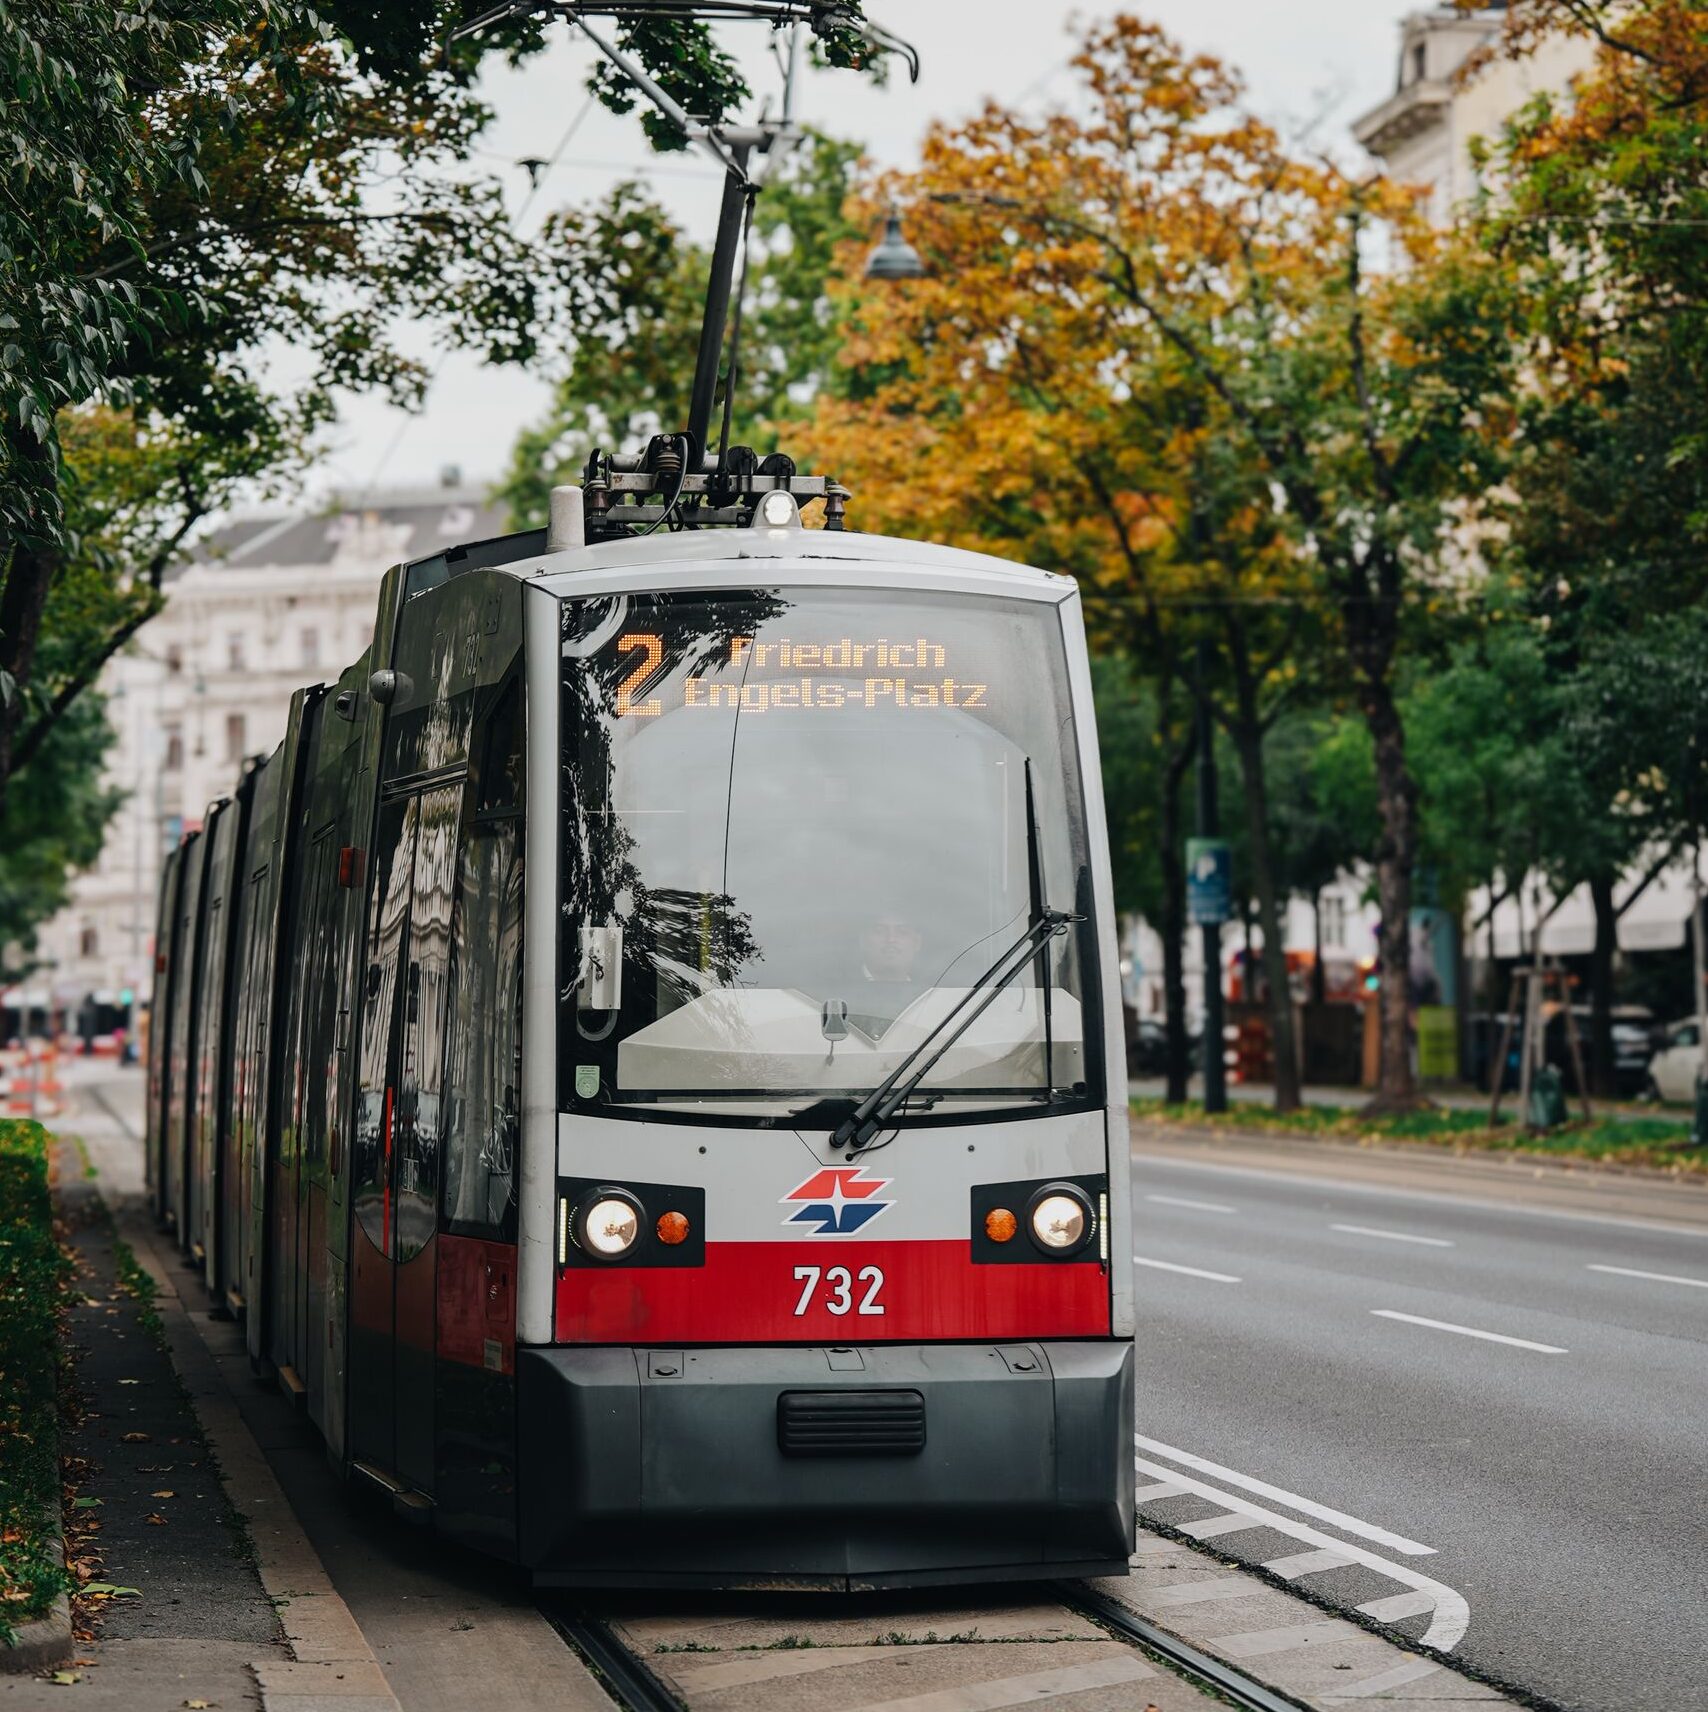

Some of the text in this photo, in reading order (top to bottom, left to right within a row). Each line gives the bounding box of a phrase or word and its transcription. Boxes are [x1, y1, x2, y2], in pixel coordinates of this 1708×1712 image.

[731, 638, 945, 667] Friedrich
[618, 635, 661, 715] 2
[685, 678, 987, 713] Engels-Platz
[793, 1265, 885, 1316] 732
